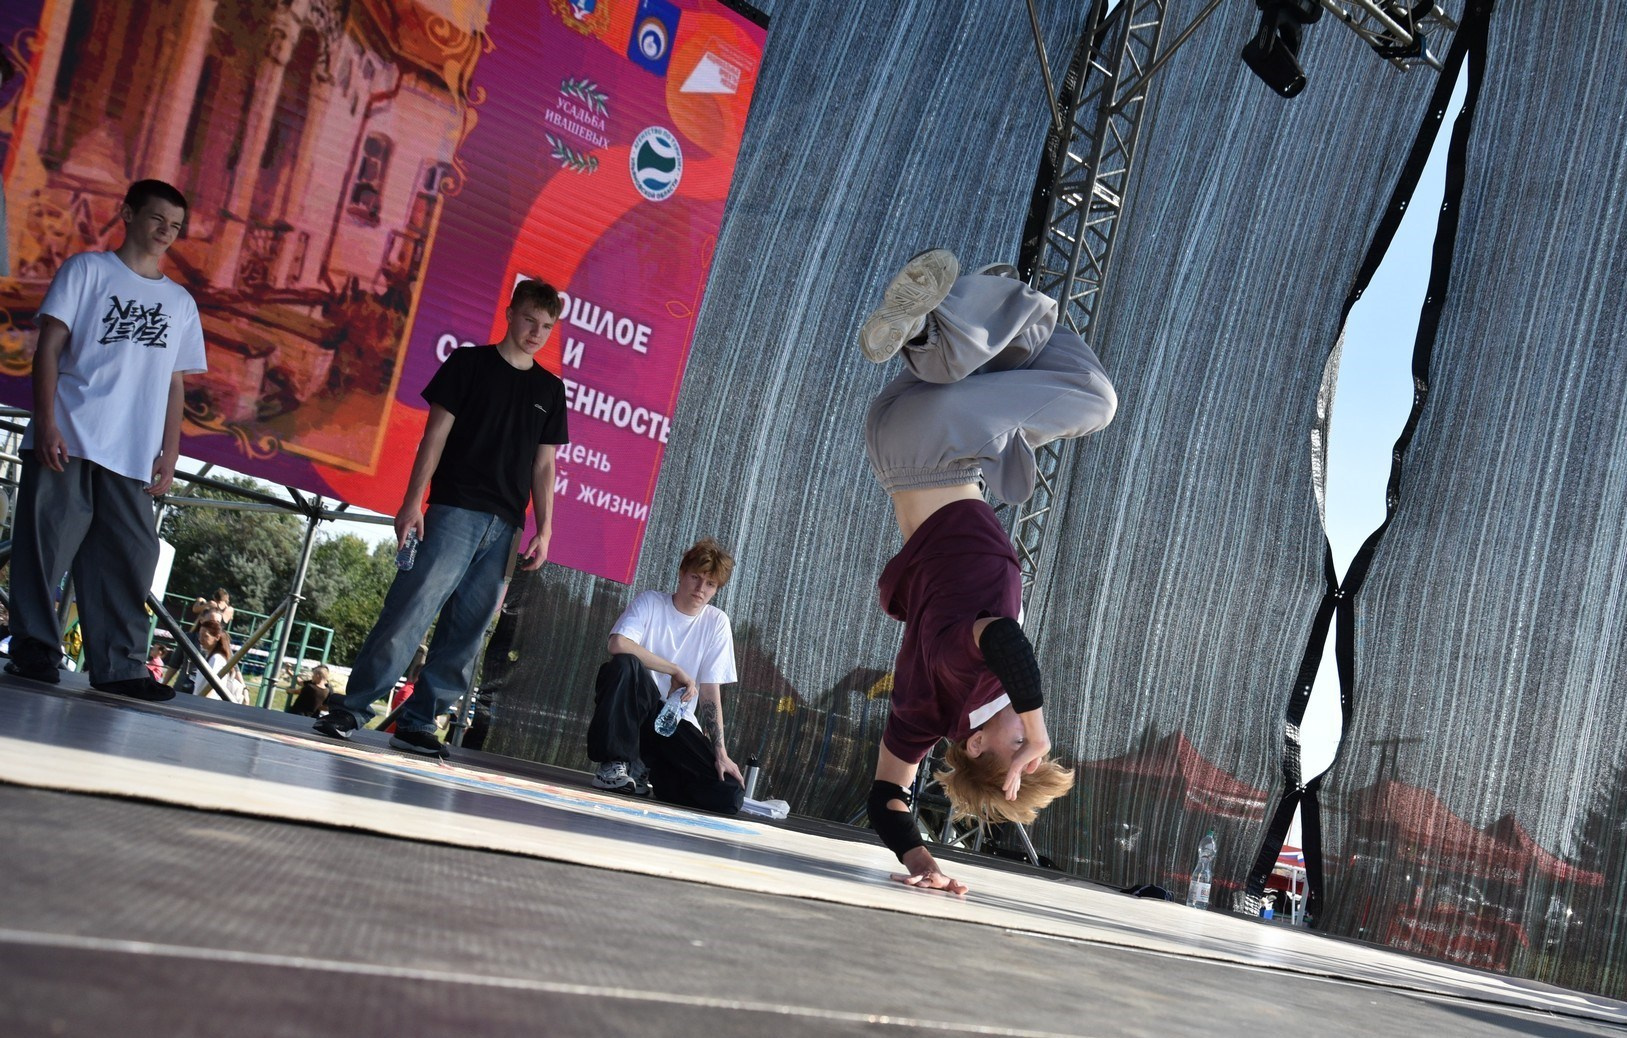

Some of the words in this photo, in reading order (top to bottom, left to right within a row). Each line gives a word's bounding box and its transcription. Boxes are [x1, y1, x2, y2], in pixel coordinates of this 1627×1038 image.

[545, 109, 610, 150] ИВАШЕВЫХ
[556, 97, 605, 131] УСАДЬБА
[562, 337, 585, 369] И
[576, 484, 648, 521] жизни
